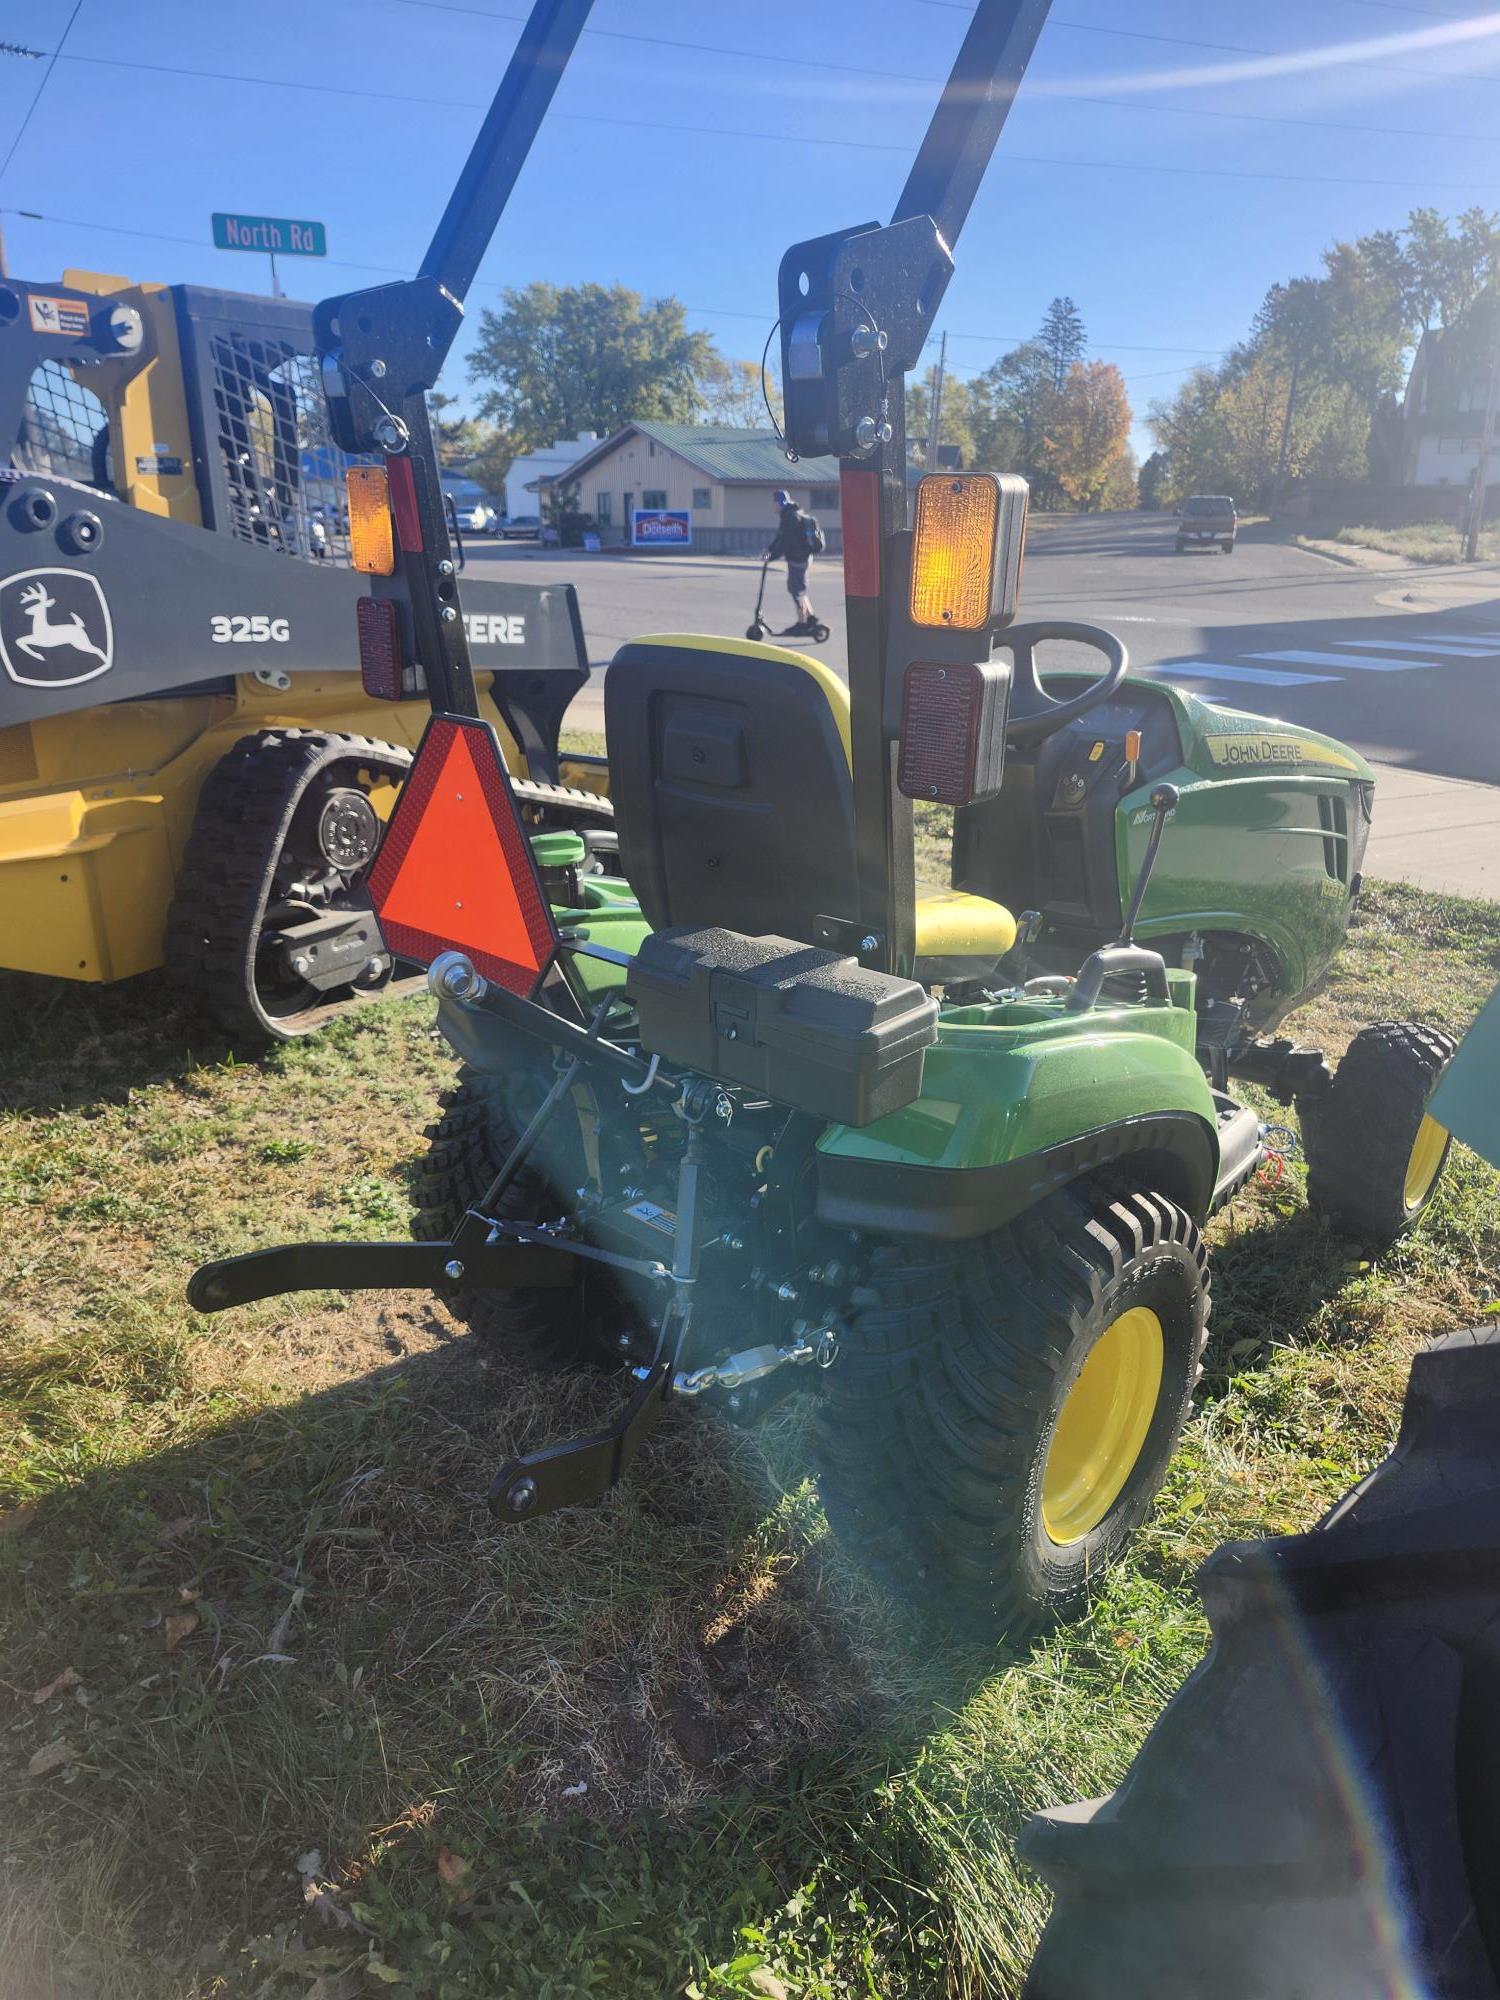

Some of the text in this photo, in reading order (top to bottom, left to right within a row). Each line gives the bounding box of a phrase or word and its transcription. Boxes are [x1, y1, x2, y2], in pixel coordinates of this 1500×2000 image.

[226, 219, 314, 251] North Rd
[210, 615, 290, 643] 325G
[462, 614, 525, 644] ERE
[1222, 741, 1302, 763] JOHN DEERE
